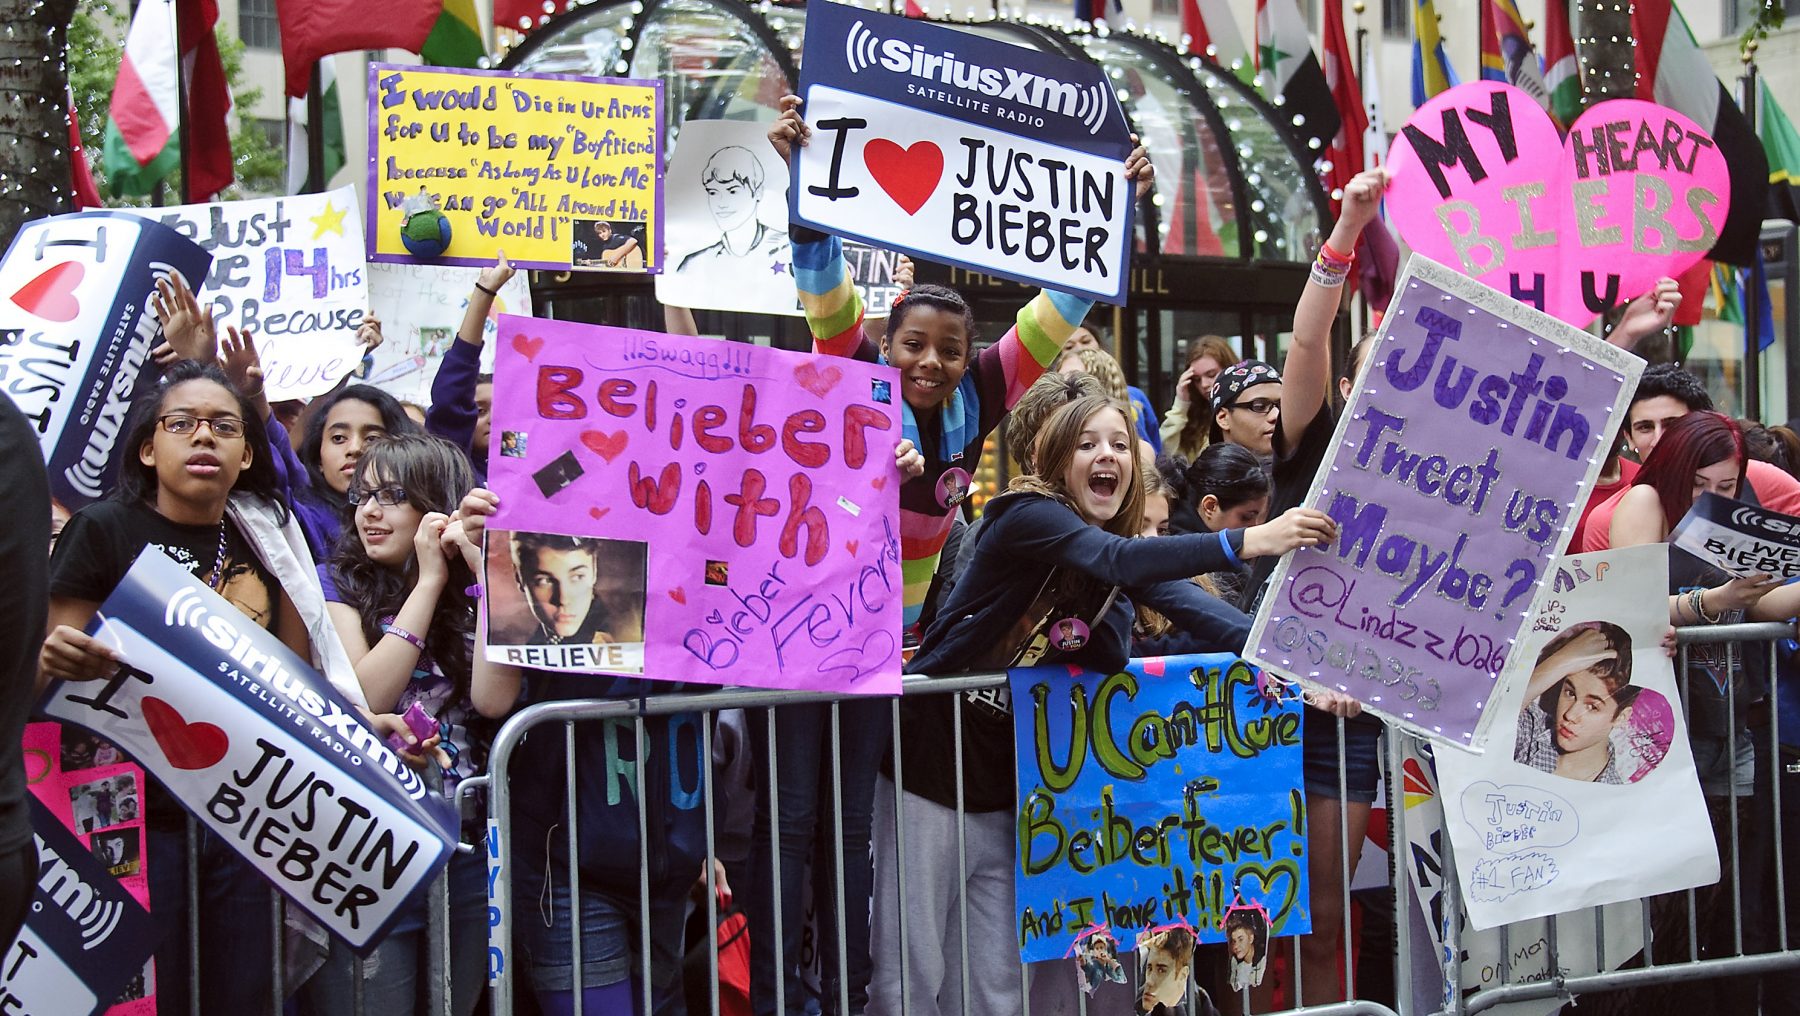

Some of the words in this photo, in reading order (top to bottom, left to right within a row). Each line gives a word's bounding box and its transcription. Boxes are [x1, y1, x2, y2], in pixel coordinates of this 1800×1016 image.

[380, 73, 407, 110] I
[413, 86, 497, 111] would
[557, 96, 576, 113] in
[581, 99, 605, 119] Ur
[907, 83, 990, 115] SATELLITE
[997, 106, 1044, 129] RADIO
[384, 113, 423, 142] for
[457, 122, 480, 146] to
[488, 125, 518, 149] be
[528, 133, 565, 160] my
[807, 117, 868, 201] I
[1401, 91, 1519, 200] MY
[1572, 118, 1714, 179] HEART
[384, 189, 409, 211] W
[482, 195, 507, 218] go
[556, 194, 615, 218] Around
[619, 200, 648, 220] the
[386, 155, 468, 181] because
[503, 160, 540, 187] Long
[542, 163, 562, 181] As
[581, 166, 617, 189] Love
[955, 137, 1115, 222] JUSTIN
[200, 200, 291, 250] Just
[951, 192, 1109, 279] BIEBER
[1435, 173, 1719, 277] BIEBS
[263, 246, 329, 303] 14
[331, 265, 361, 291] hrs
[1580, 271, 1620, 313] U
[100, 303, 135, 376] SATELLITE
[241, 298, 364, 336] Because
[80, 379, 105, 425] RADIO
[1386, 306, 1590, 461] Justin
[536, 365, 892, 470] Belieber
[1353, 405, 1502, 515] Tweet
[628, 460, 830, 567] with
[1704, 538, 1800, 578] BIEBE
[1752, 542, 1798, 561] WE
[684, 560, 788, 671] Bieber
[507, 645, 625, 668] BELIEVE
[65, 663, 155, 719] I
[217, 661, 307, 727] SATELLITE
[311, 726, 363, 767] RADIO
[1030, 683, 1088, 793] U
[1224, 660, 1300, 758] Cure
[233, 738, 418, 890] JUSTIN
[1019, 784, 1181, 876] Beiber
[207, 782, 380, 929] BIEBER
[1477, 867, 1505, 889] #1
[1511, 866, 1543, 888] FAN
[1020, 899, 1063, 946] And
[1066, 897, 1095, 930] I
[1104, 890, 1158, 930] have
